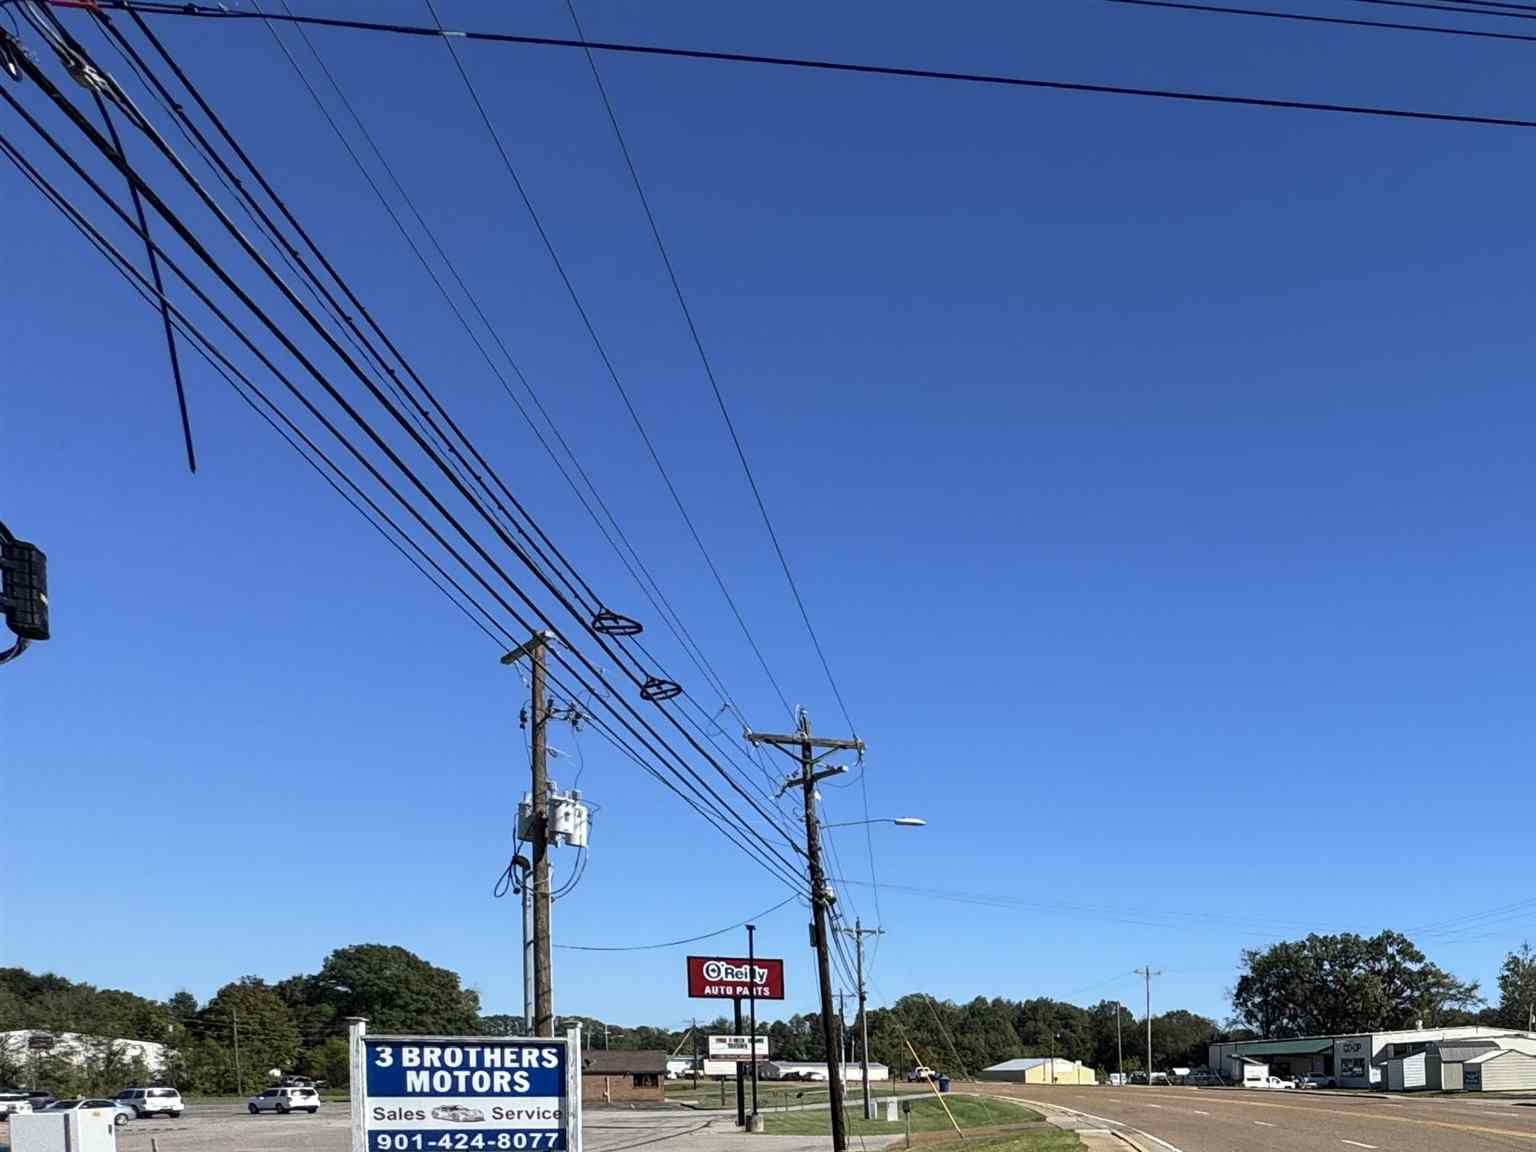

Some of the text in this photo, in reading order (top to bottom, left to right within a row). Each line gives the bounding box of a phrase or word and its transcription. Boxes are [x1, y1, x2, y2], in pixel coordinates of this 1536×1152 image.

[704, 961, 767, 984] O'Reily
[704, 986, 732, 995] AUTO
[375, 1046, 559, 1068] 3 BROTHERS
[406, 1070, 530, 1093] MOTORS
[373, 1106, 562, 1121] Sales Service
[377, 1133, 559, 1150] 901-424-8077
